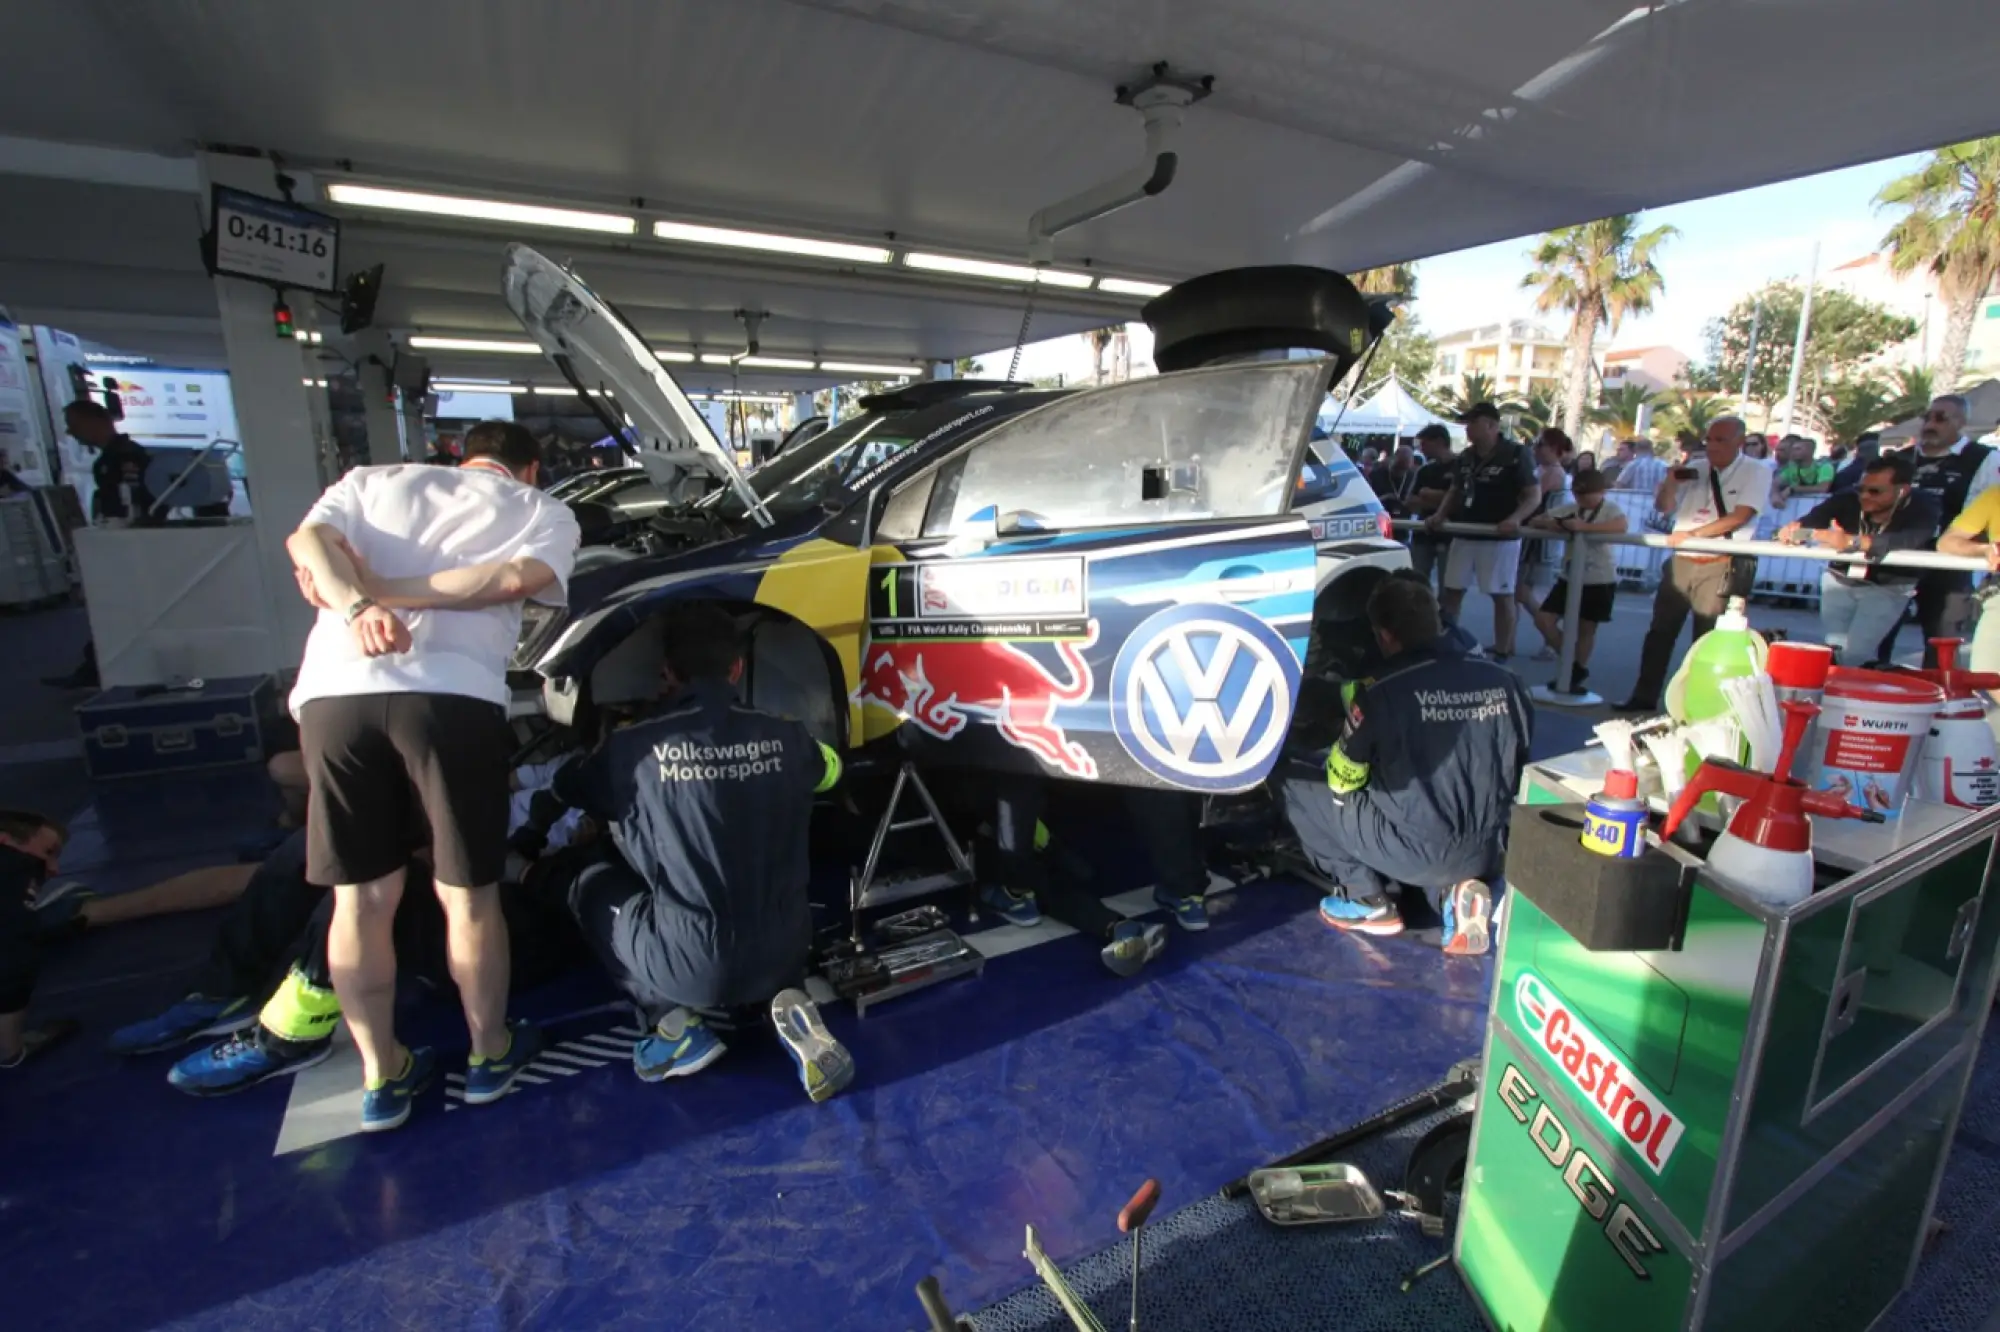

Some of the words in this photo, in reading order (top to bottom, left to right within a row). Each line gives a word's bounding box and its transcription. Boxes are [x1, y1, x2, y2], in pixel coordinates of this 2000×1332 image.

[228, 216, 327, 258] 0:41:16
[850, 405, 994, 492] www.volkswagen-motorsport.com
[1327, 519, 1377, 538] EDGE
[881, 568, 897, 618] 1
[923, 625, 946, 635] World
[948, 625, 968, 636] Rally
[971, 624, 1032, 635] Championship
[1414, 687, 1507, 705] Volkswagen
[1421, 702, 1509, 722] Motorsport
[652, 740, 783, 761] Volkswagen
[660, 757, 782, 782] Motorsport
[1544, 1008, 1673, 1168] Castrol
[1497, 1062, 1668, 1281] EDGE
